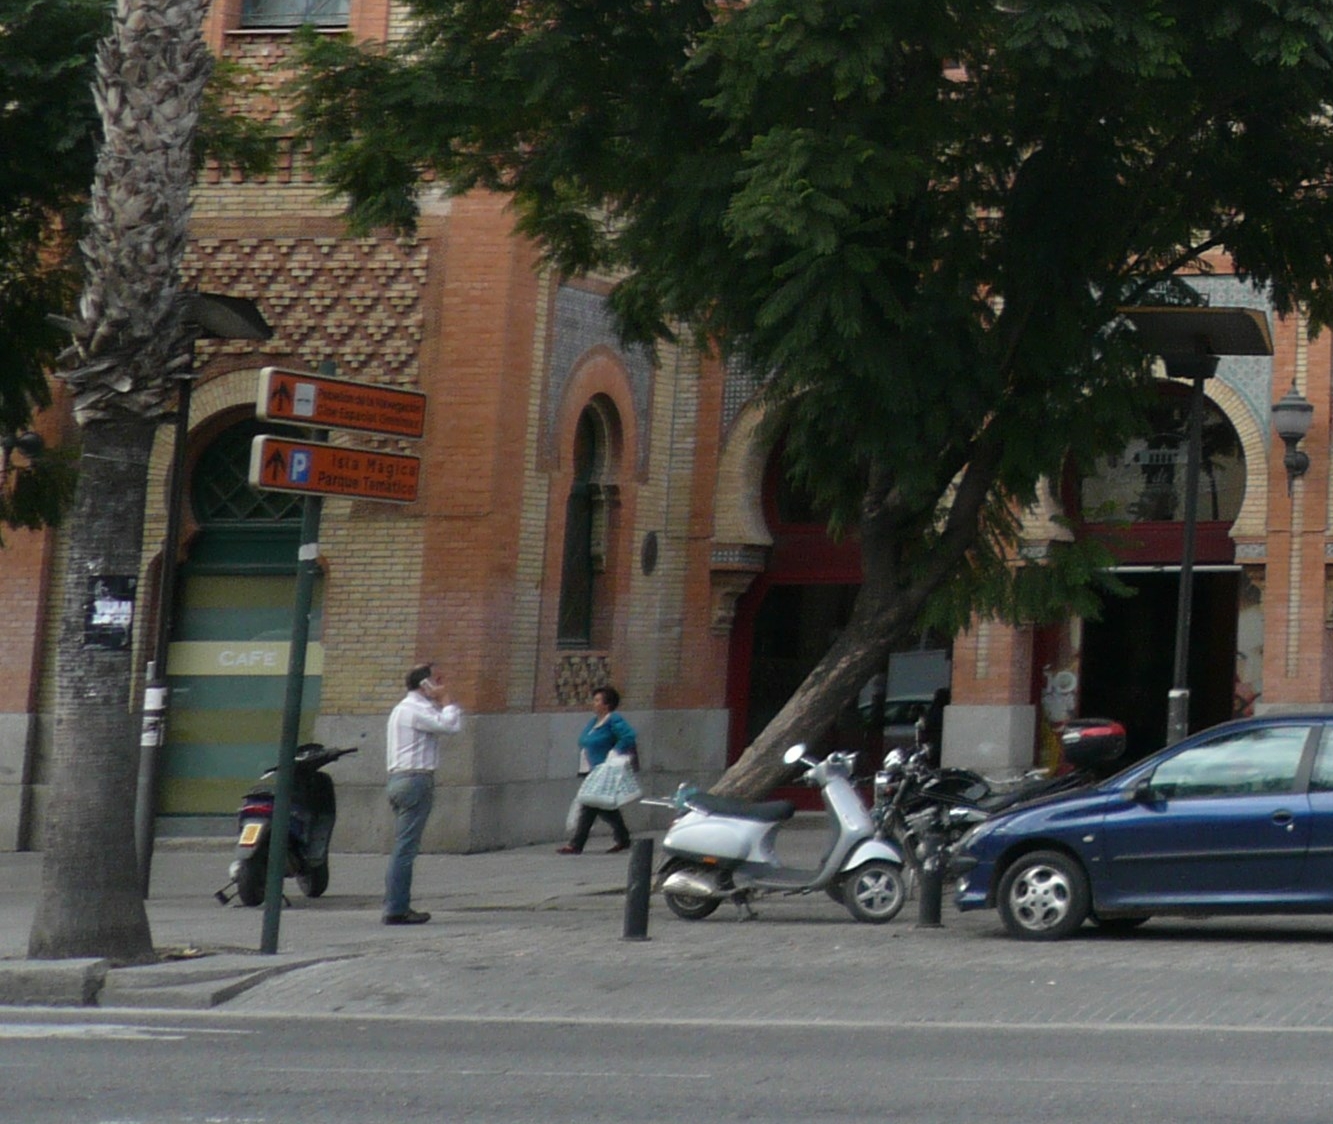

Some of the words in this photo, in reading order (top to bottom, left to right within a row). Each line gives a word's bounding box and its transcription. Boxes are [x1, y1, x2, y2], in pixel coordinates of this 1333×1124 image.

[291, 452, 307, 481] P
[331, 453, 360, 471] Isla
[317, 471, 359, 491] Parque
